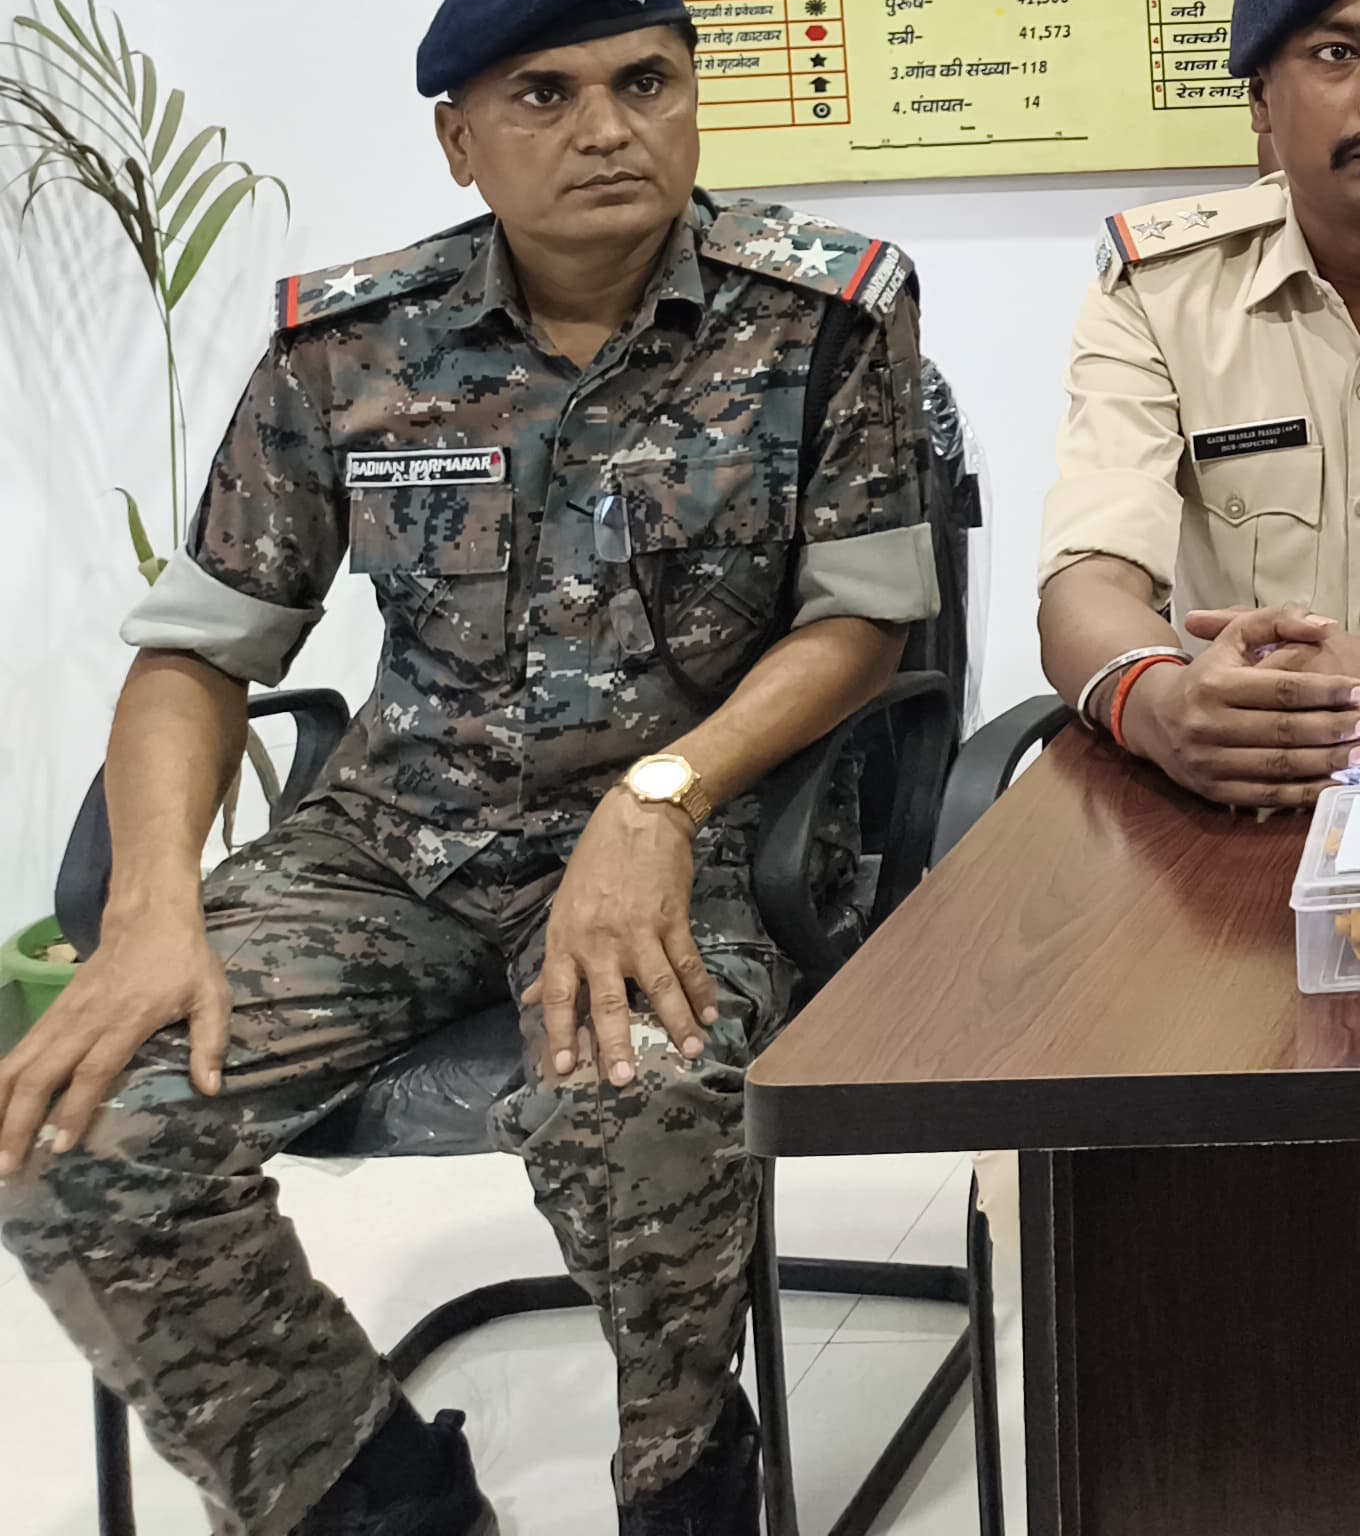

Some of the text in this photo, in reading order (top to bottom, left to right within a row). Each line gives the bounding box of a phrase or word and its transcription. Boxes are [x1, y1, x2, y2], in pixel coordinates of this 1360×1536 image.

[1171, 1, 1205, 18] नदी
[1019, 25, 1071, 40] 41,573
[1173, 27, 1227, 44] पक्की
[939, 57, 963, 77] की
[1175, 59, 1217, 71] थाना
[1176, 83, 1204, 98] रेल
[1024, 96, 1041, 109] 14
